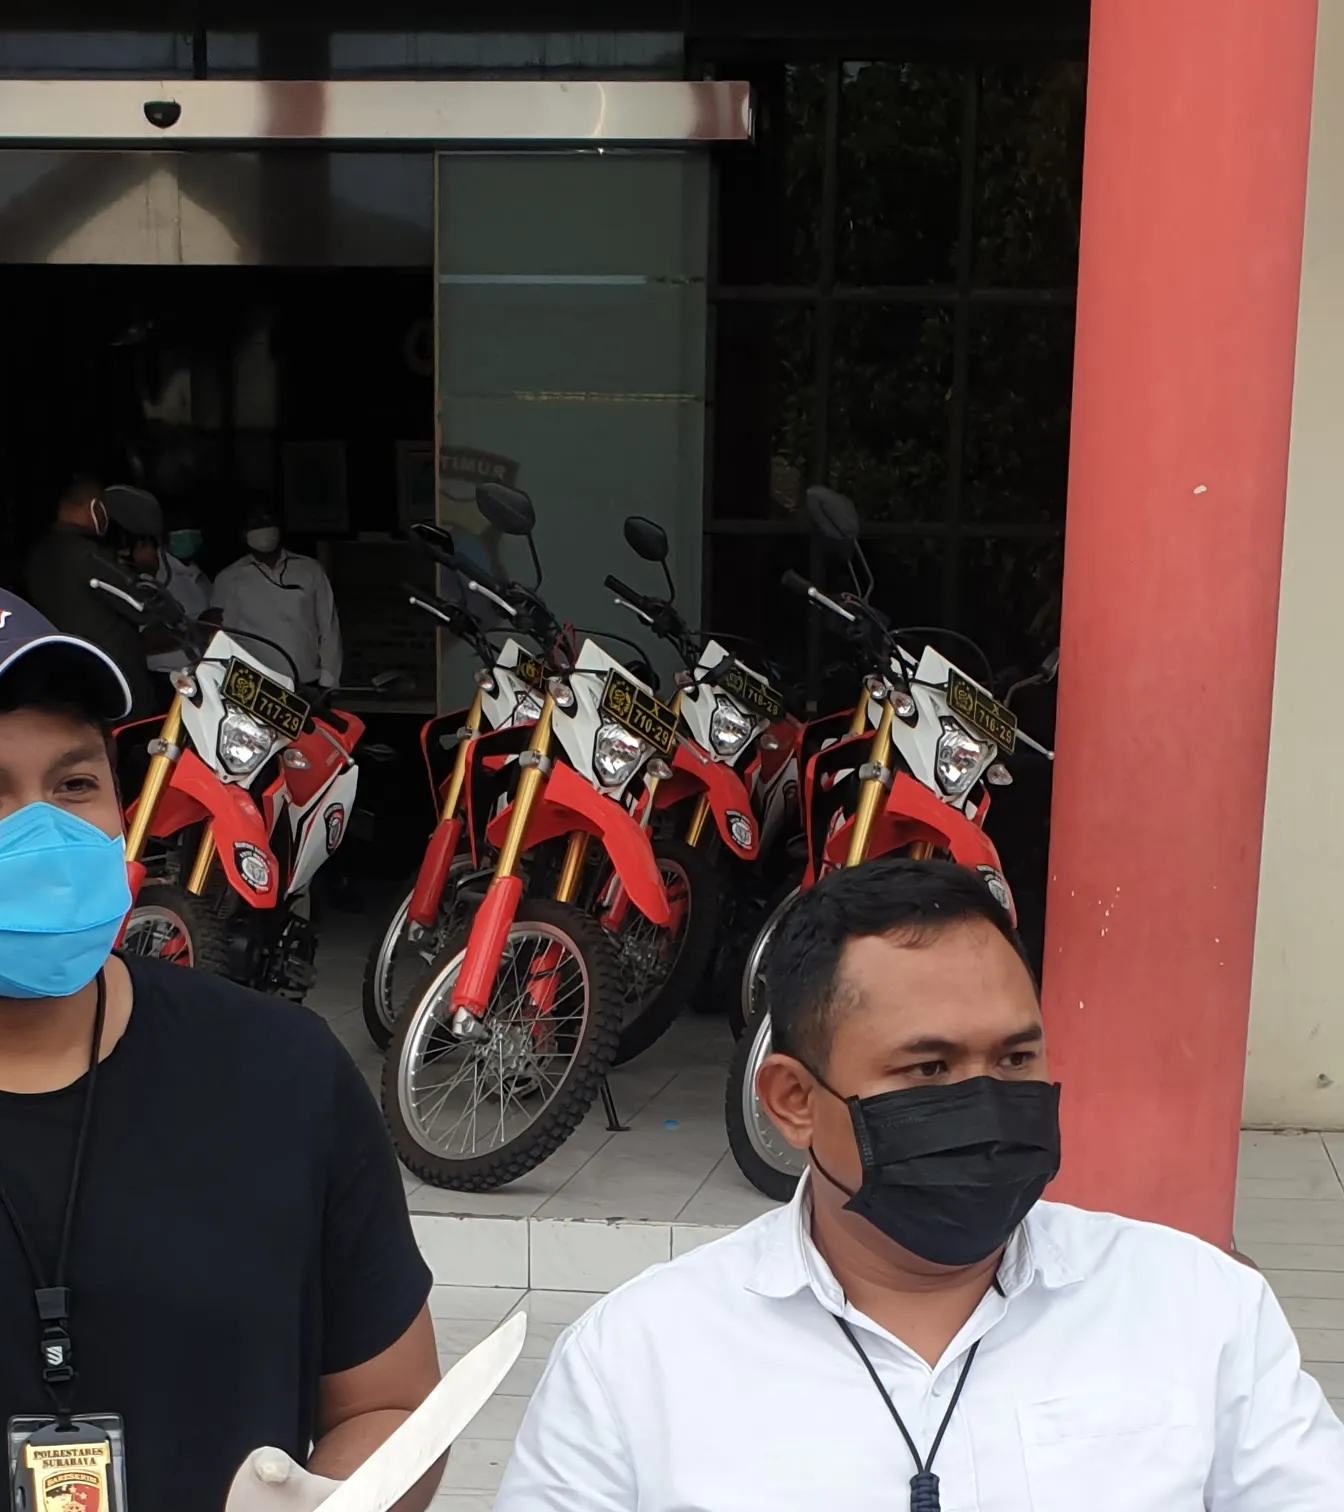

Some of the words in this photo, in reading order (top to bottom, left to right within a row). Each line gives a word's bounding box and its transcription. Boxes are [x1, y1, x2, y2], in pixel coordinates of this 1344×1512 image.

[259, 696, 300, 732] 717-29
[632, 707, 670, 746] 710-29
[42, 1459, 97, 1469] SURABAYA
